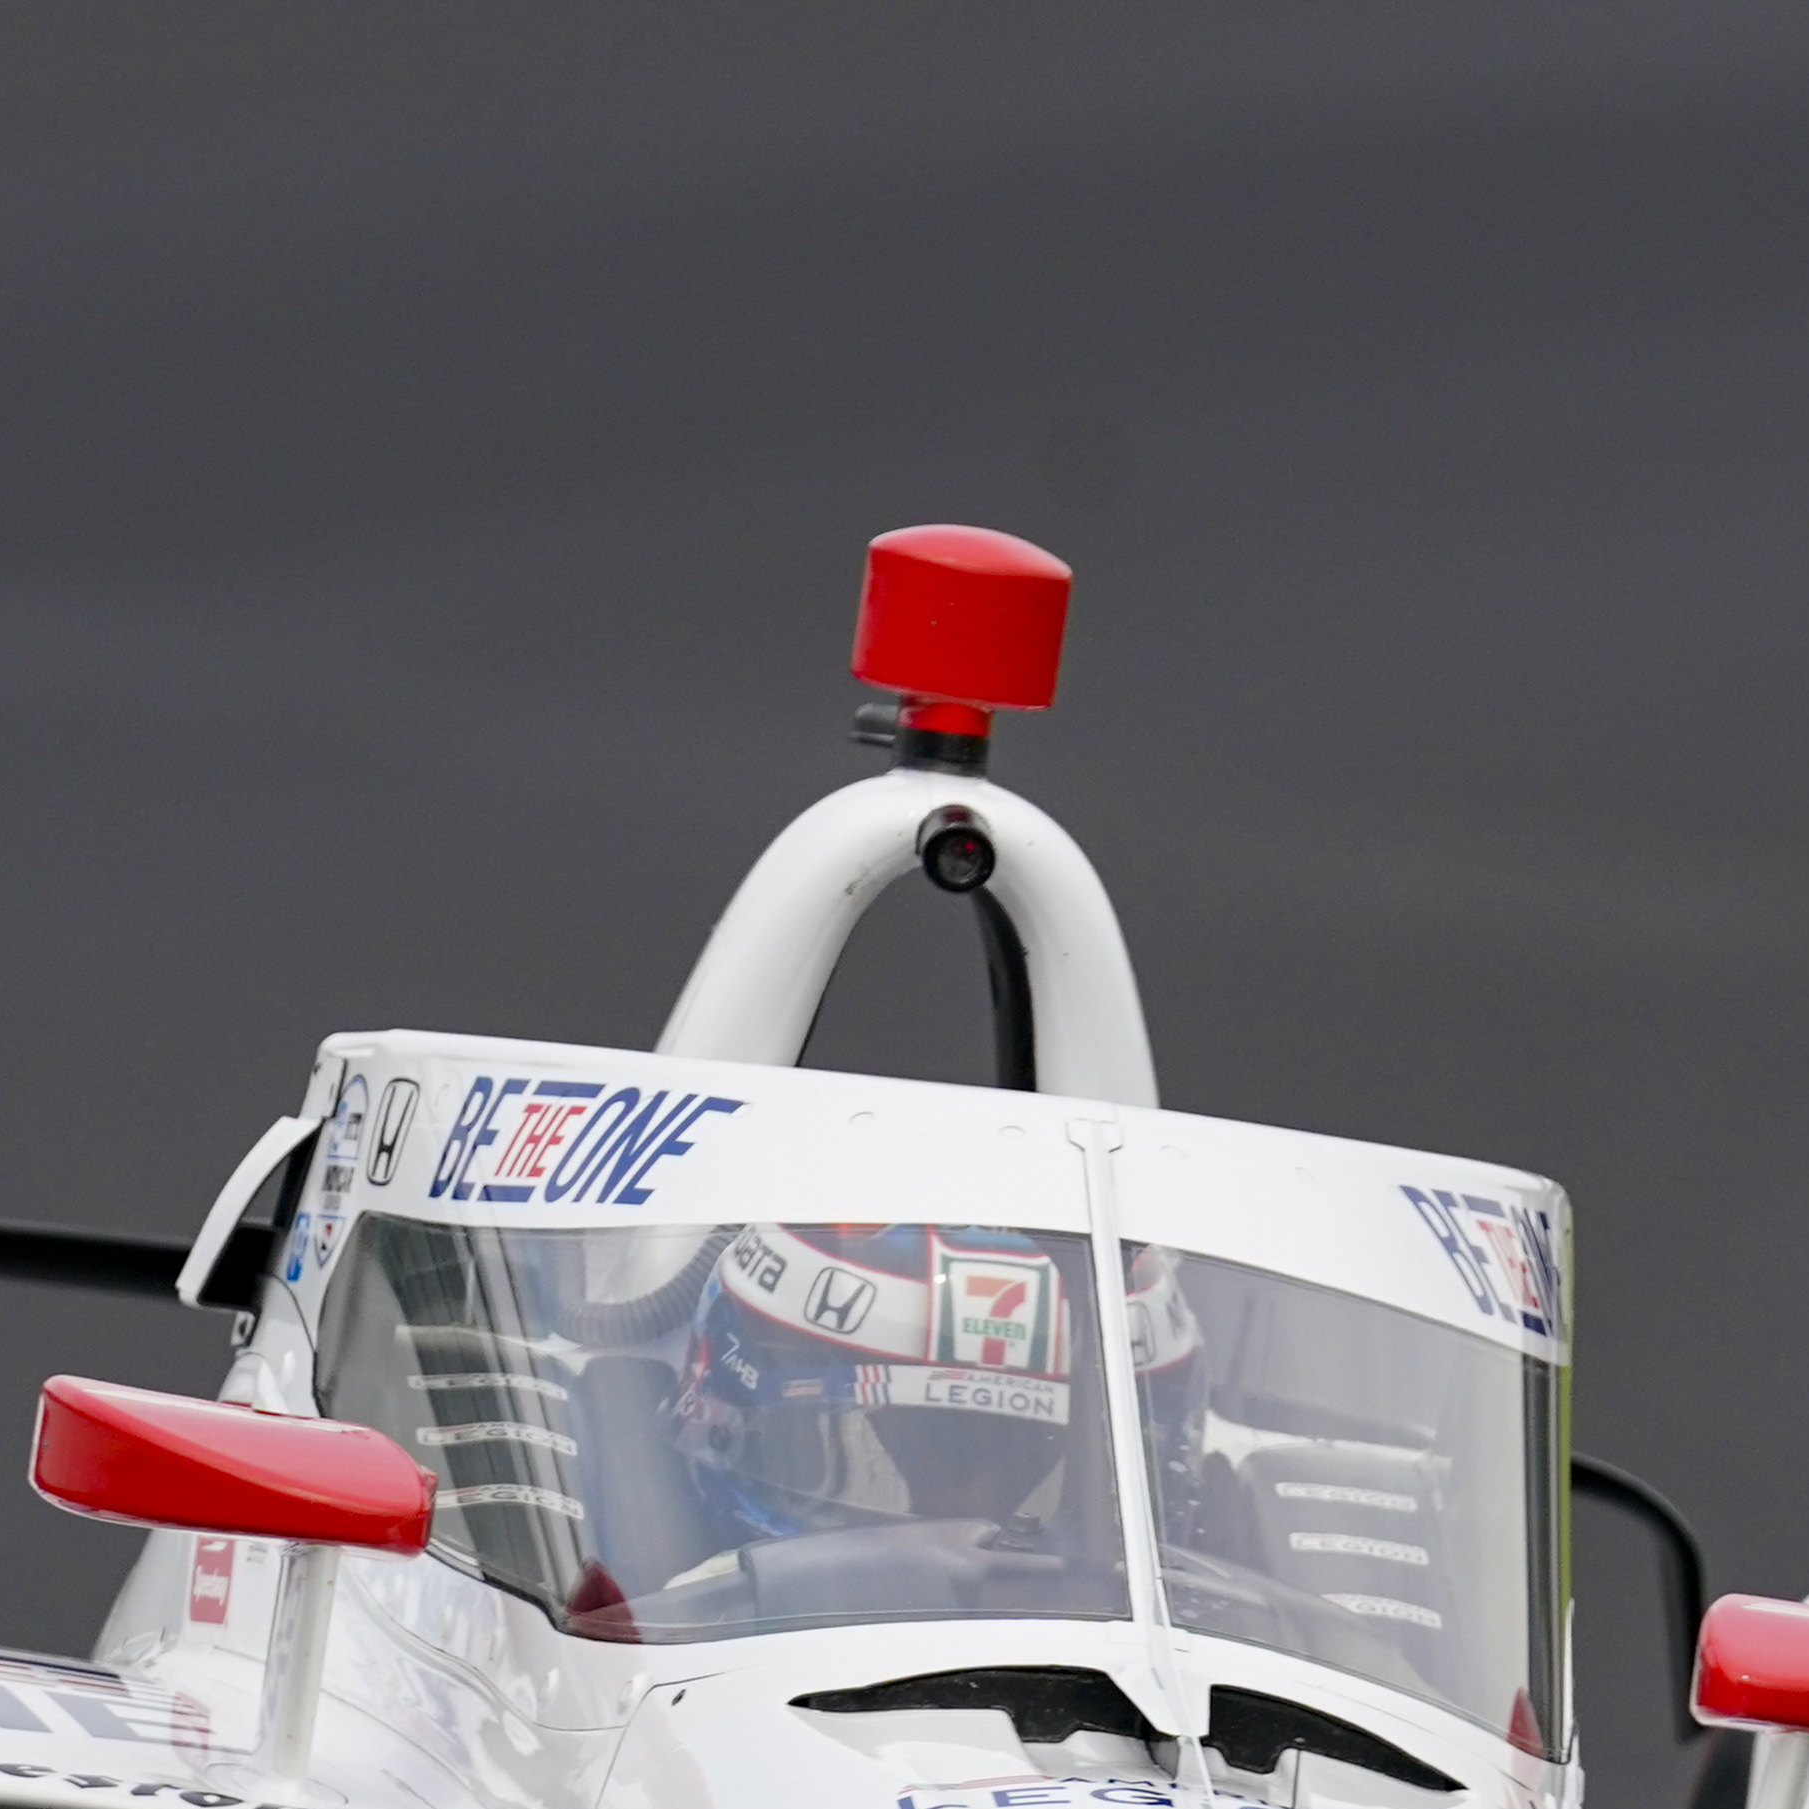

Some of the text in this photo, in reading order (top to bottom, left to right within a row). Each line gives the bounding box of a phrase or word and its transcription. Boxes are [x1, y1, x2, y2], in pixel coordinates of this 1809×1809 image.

[428, 1075, 751, 1206] BE THE ONE
[924, 1382, 1055, 1416] LEGION
